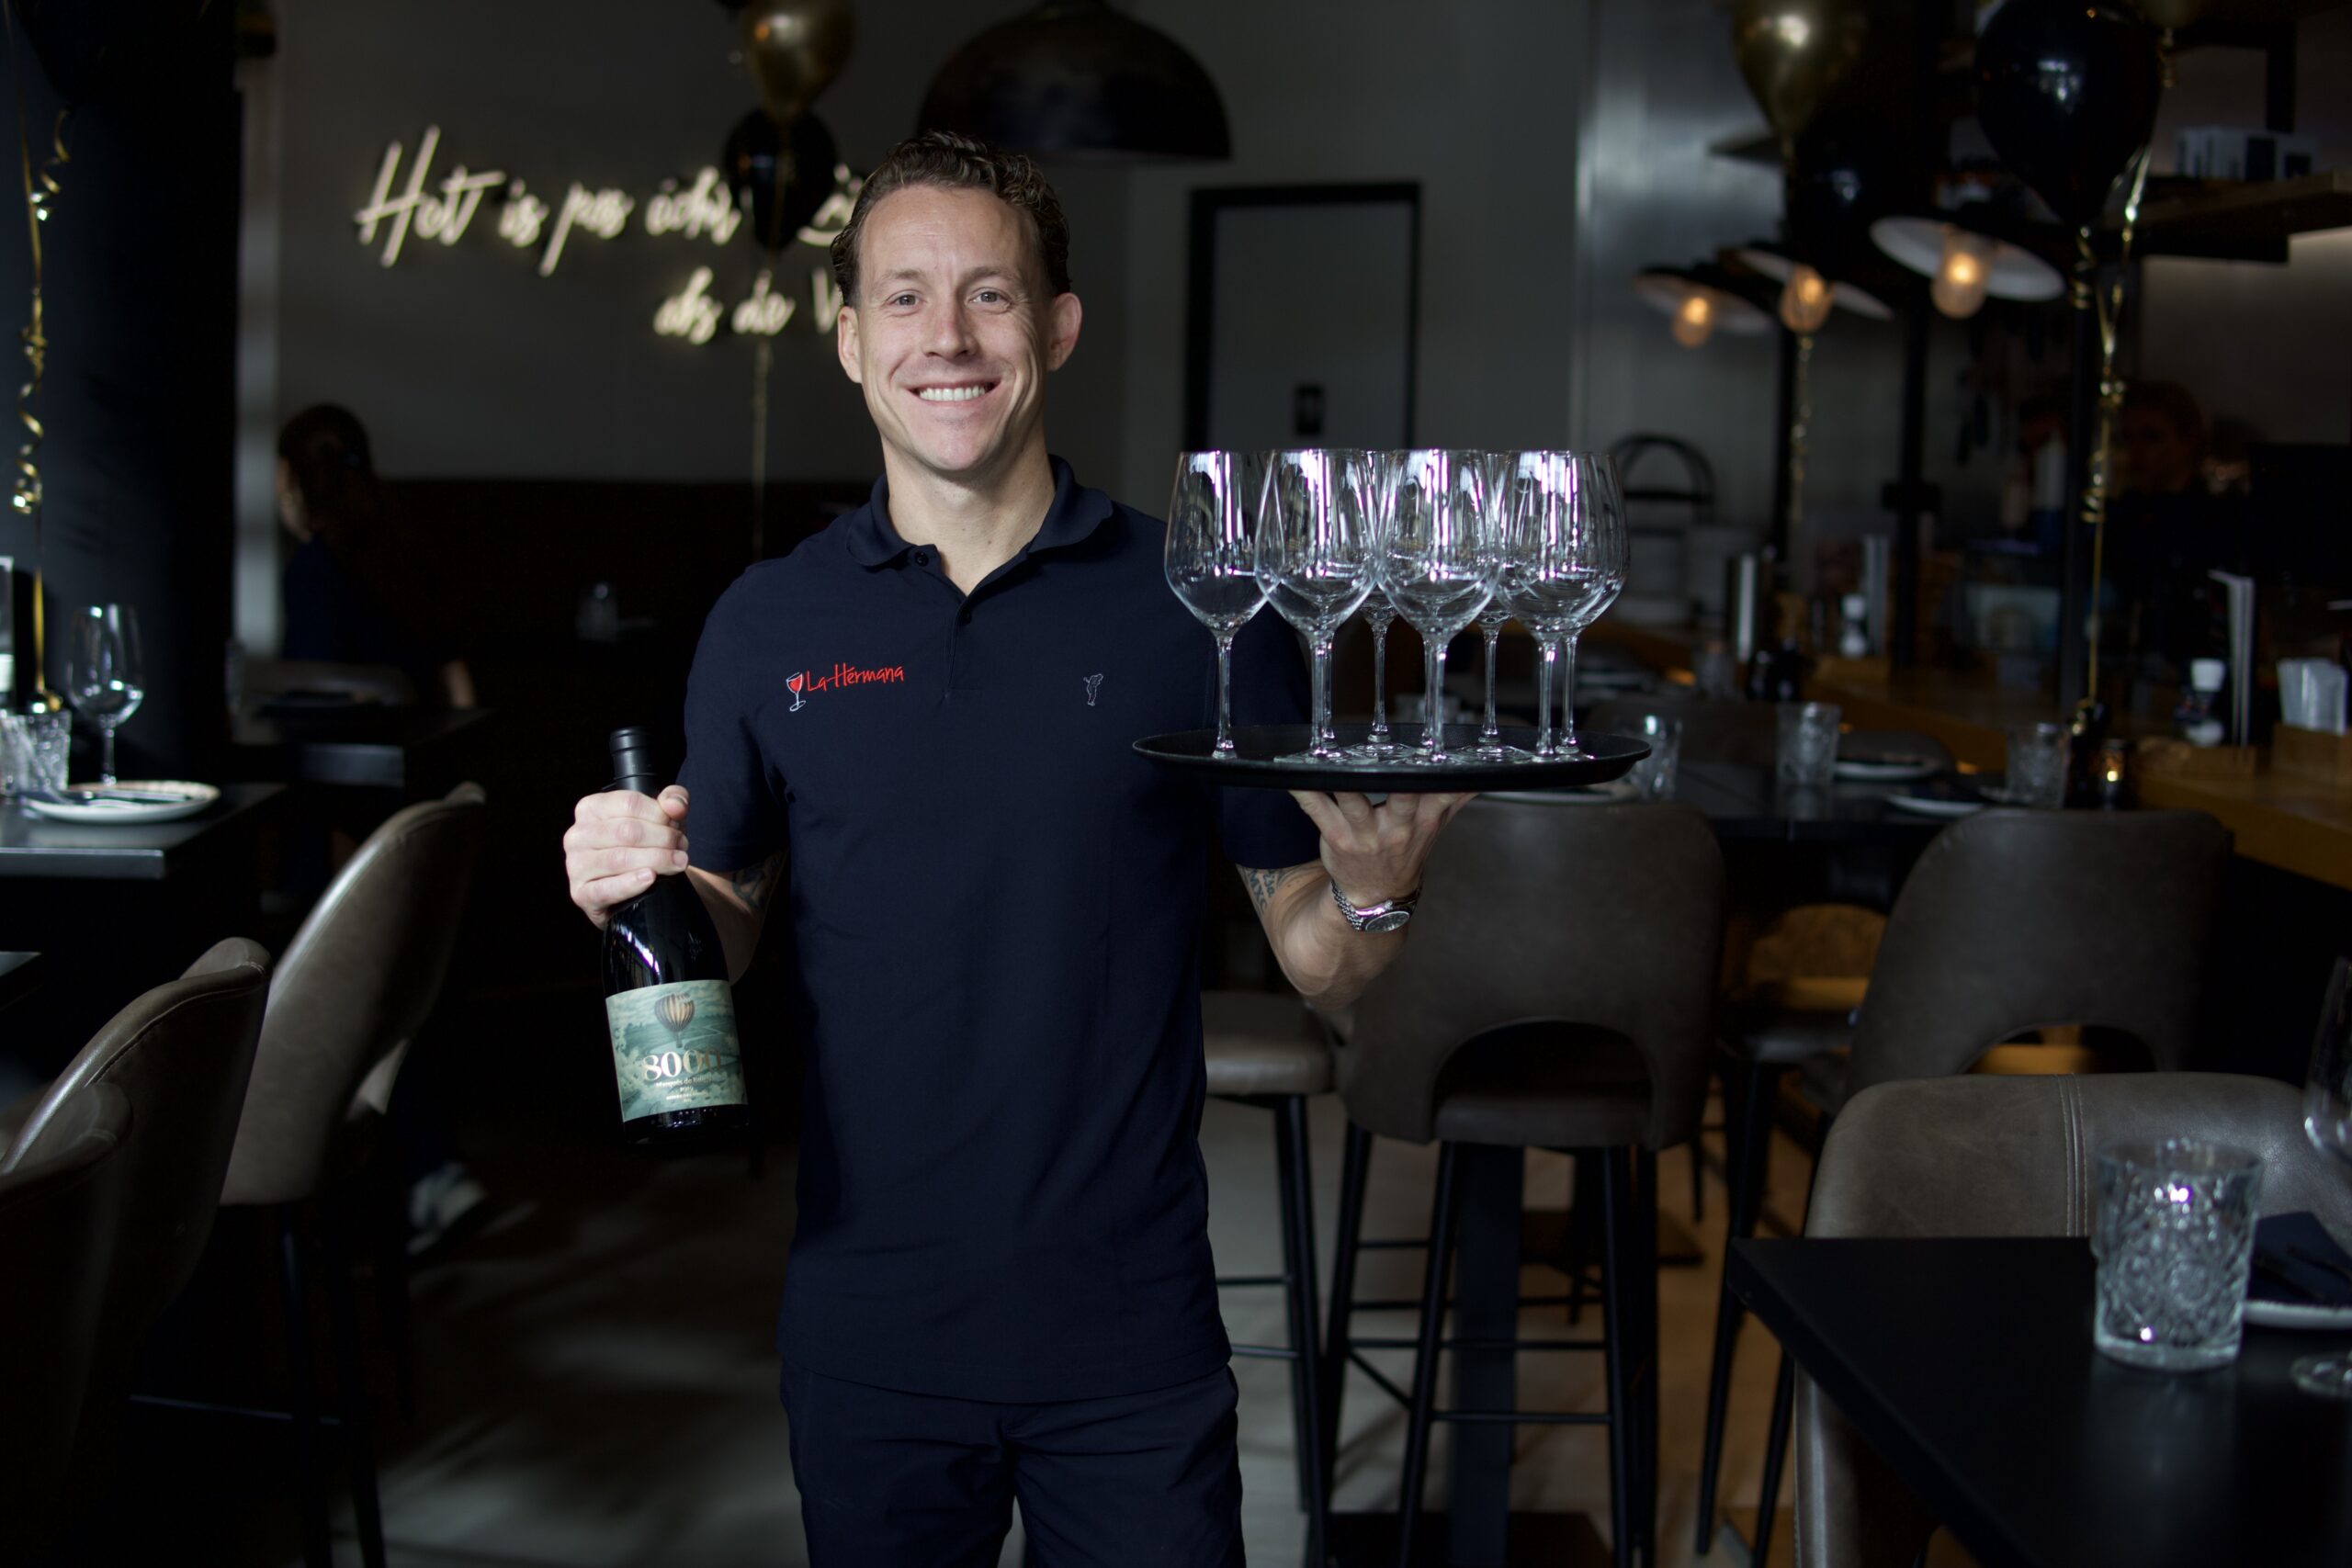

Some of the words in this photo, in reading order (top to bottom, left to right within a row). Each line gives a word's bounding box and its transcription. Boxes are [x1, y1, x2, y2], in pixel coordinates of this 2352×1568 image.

[354, 124, 505, 268] Het
[499, 178, 549, 248] is
[731, 267, 796, 337] de
[807, 670, 827, 692] La
[827, 661, 904, 688] Hermana
[642, 1045, 721, 1081] 8000
